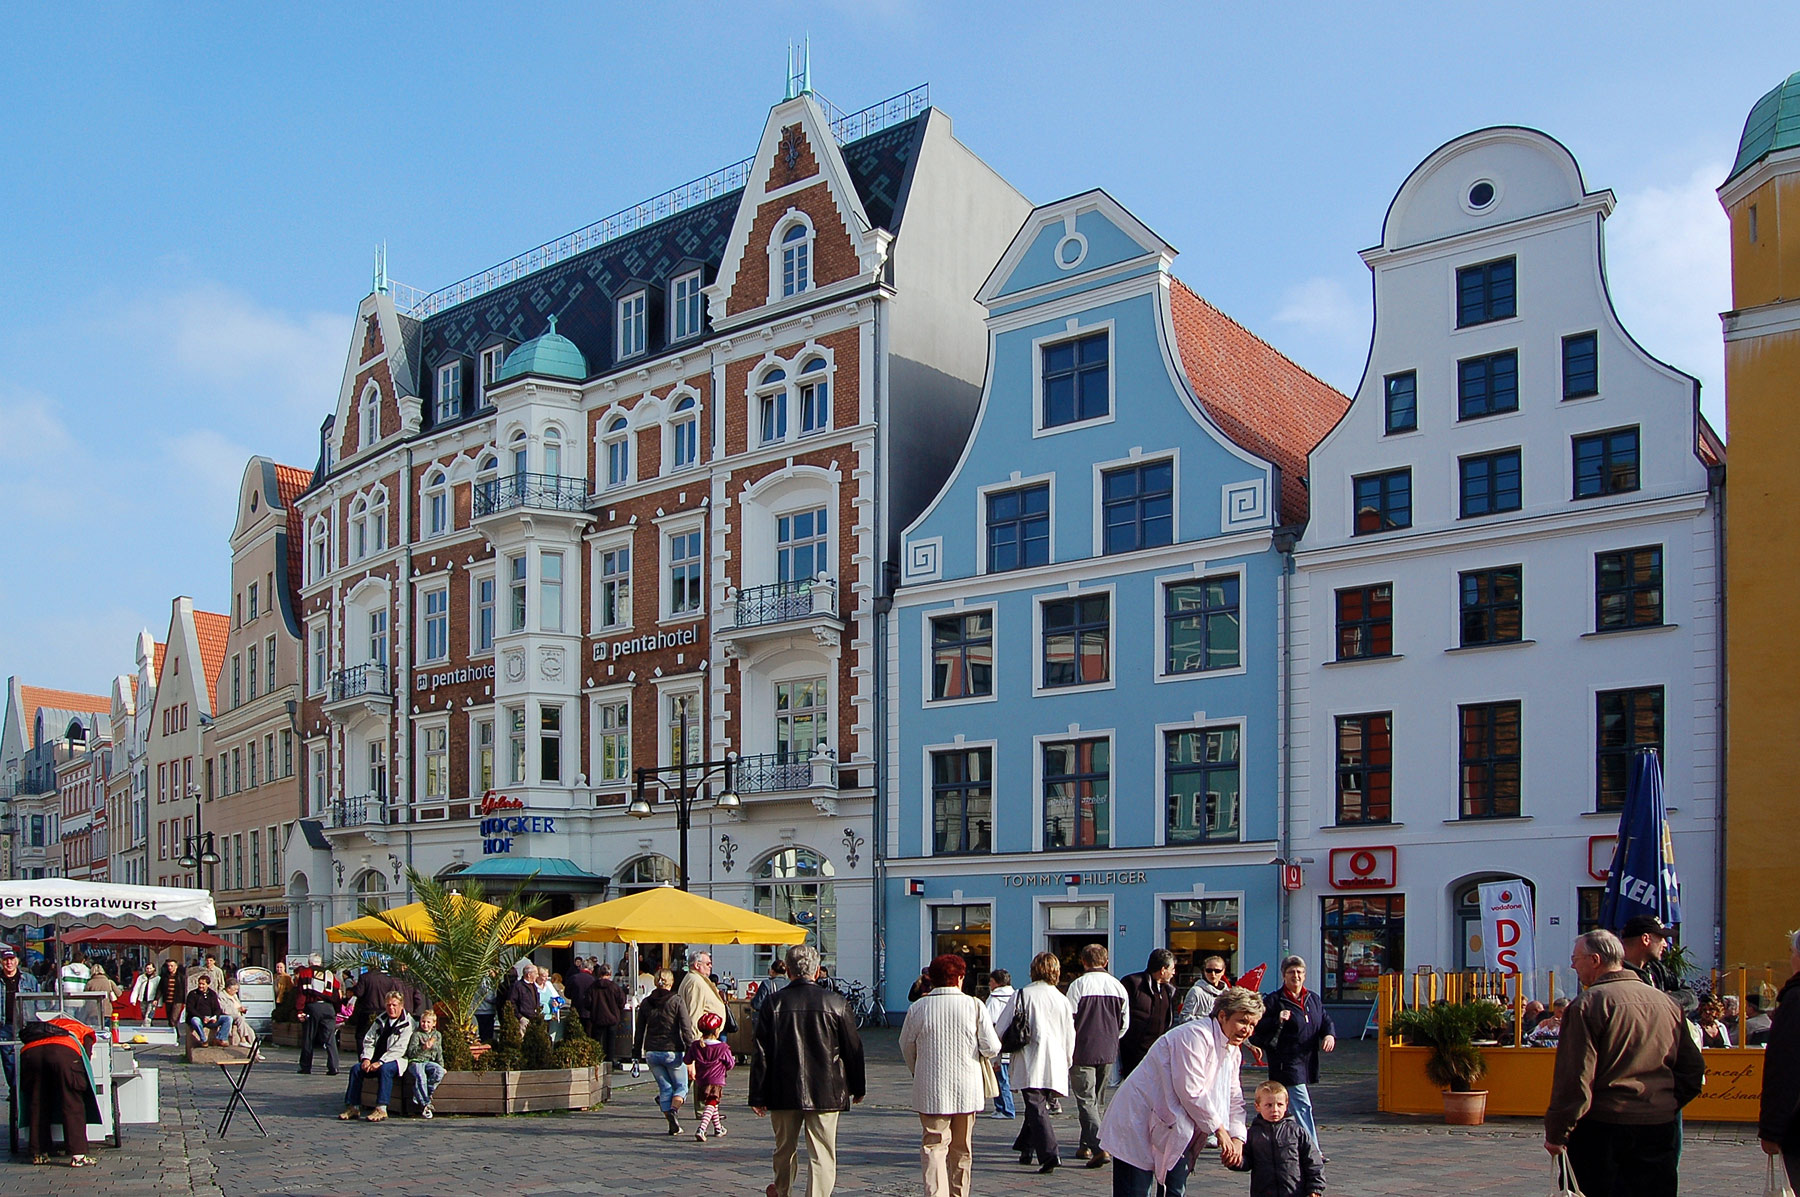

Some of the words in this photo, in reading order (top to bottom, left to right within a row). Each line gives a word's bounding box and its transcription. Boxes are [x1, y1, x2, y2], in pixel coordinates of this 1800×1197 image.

[612, 624, 697, 661] pentahotel
[432, 664, 494, 691] pentahote
[1003, 874, 1062, 887] TOMMY
[1083, 871, 1147, 885] HILFIGER
[30, 895, 157, 910] Rostbratwurst
[1491, 903, 1522, 912] vodafone
